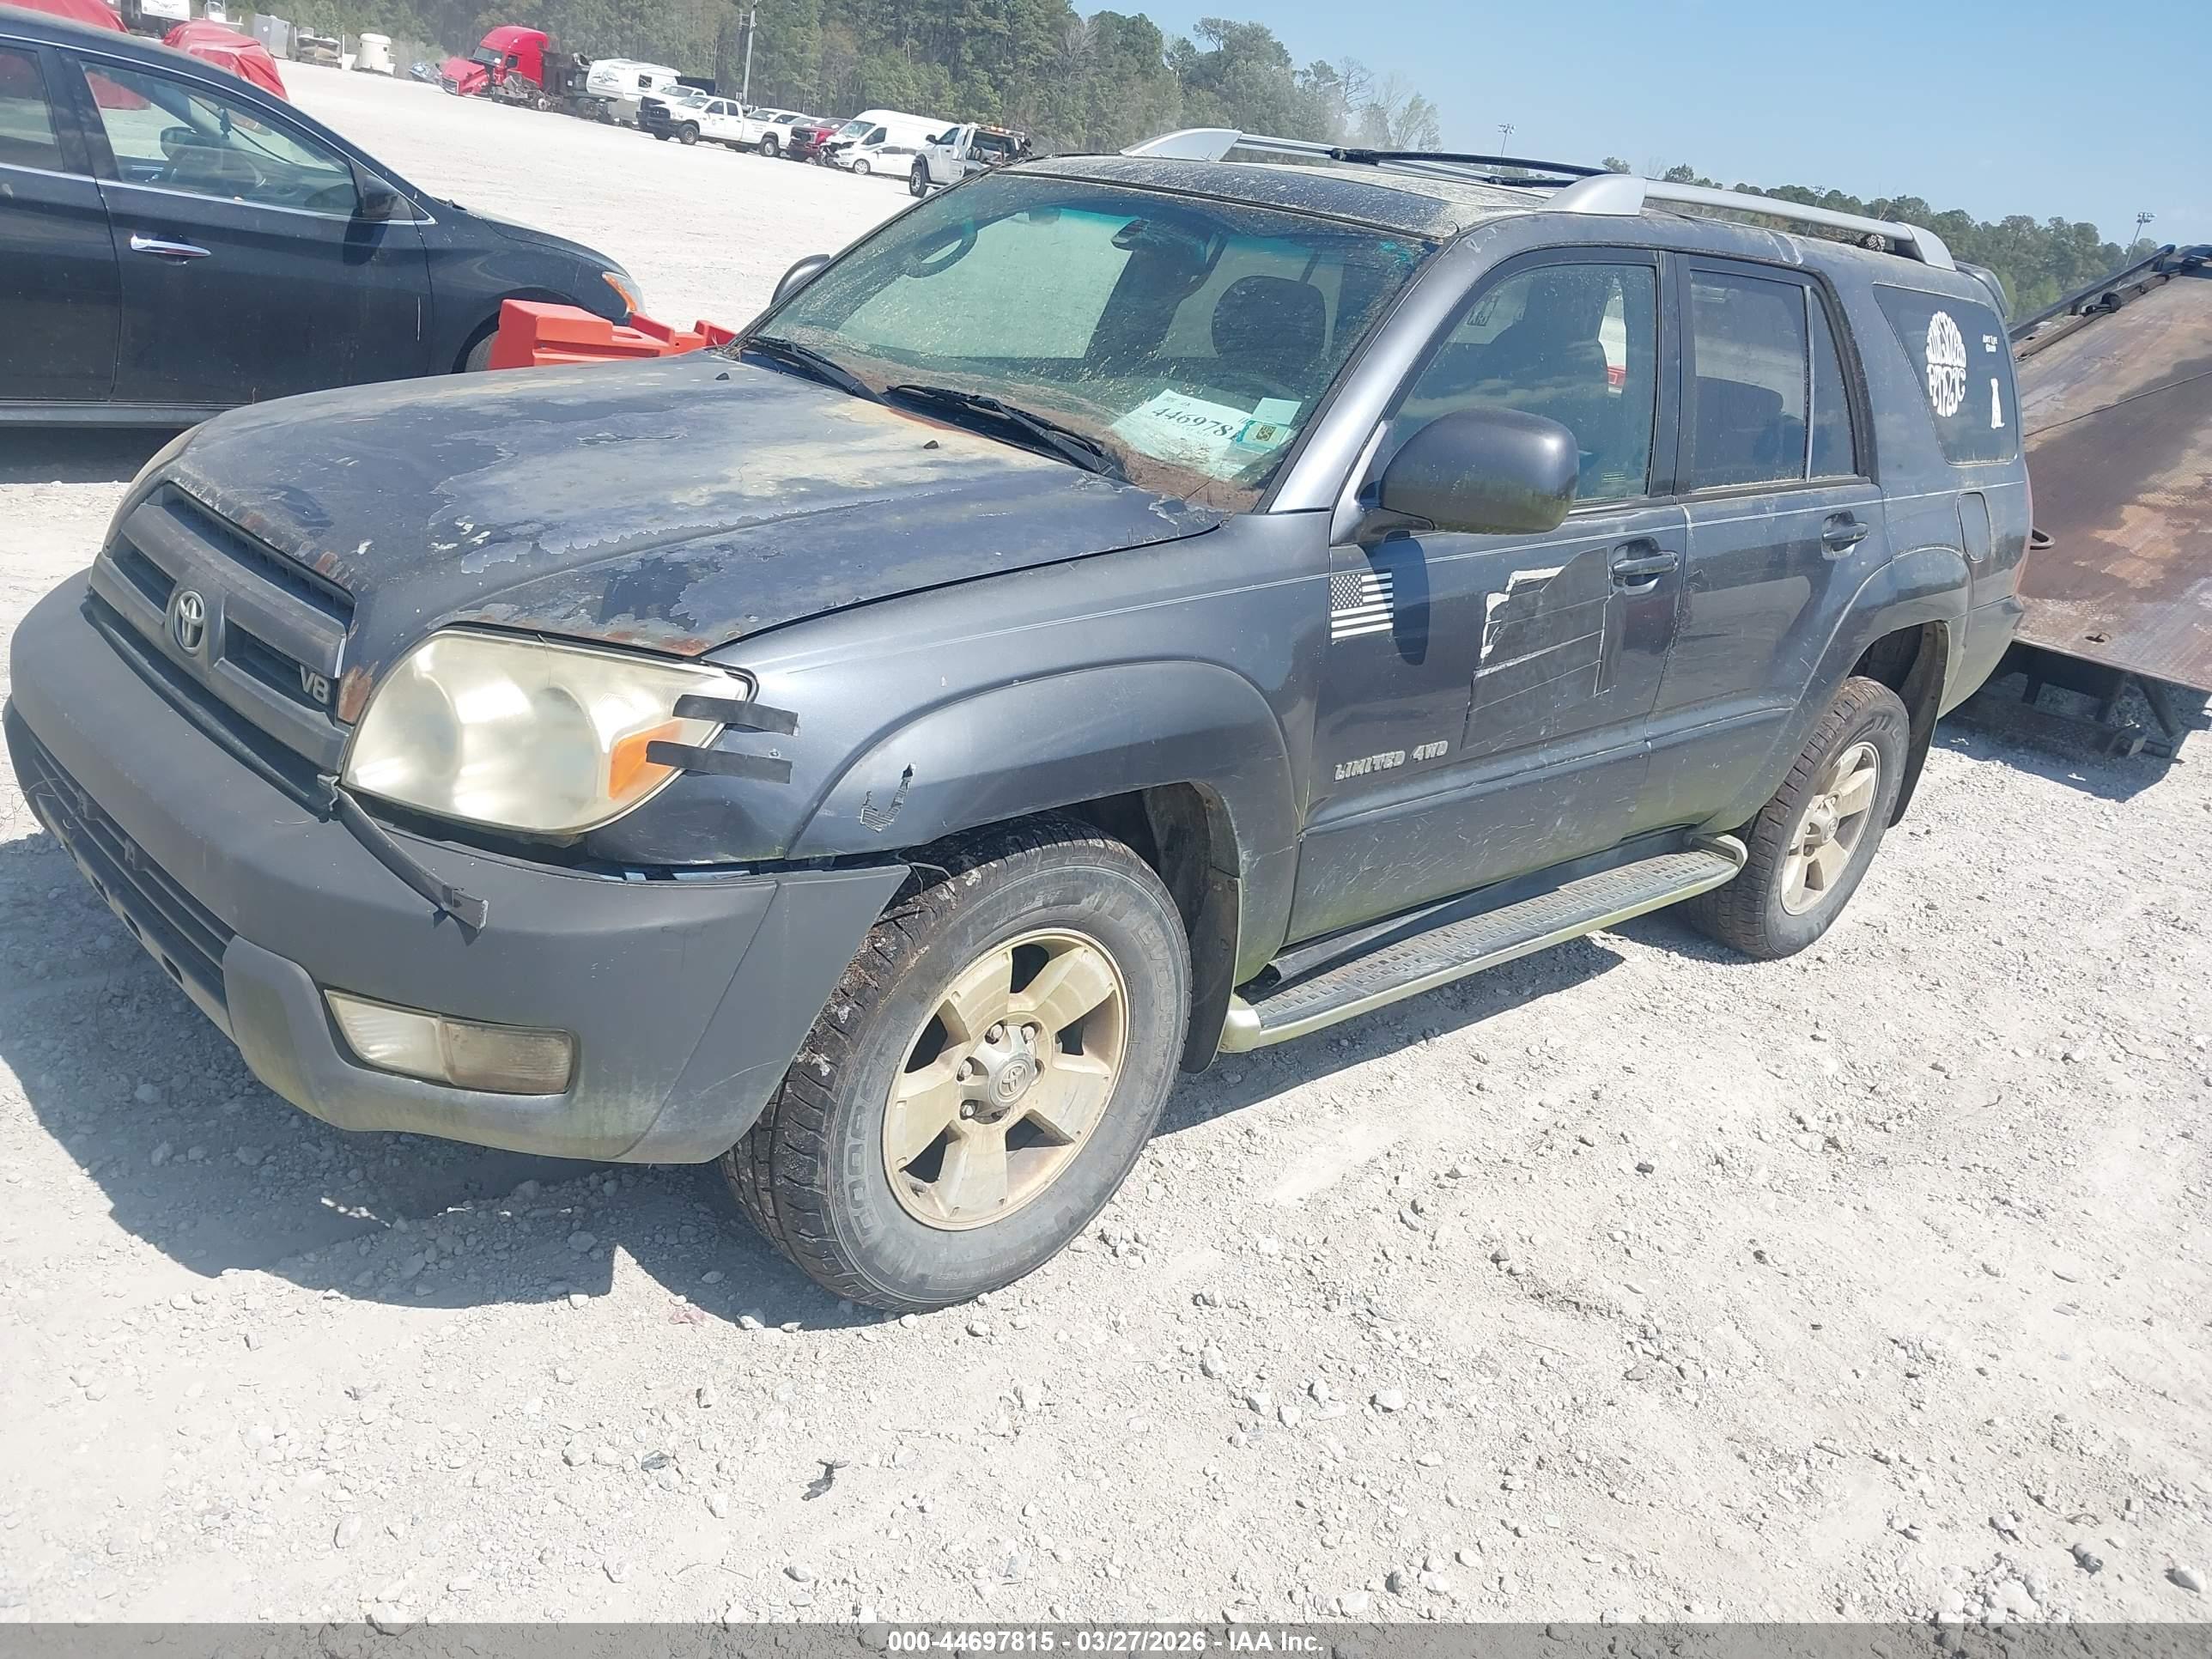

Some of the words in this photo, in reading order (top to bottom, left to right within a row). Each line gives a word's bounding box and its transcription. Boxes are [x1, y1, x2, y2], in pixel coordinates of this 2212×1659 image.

[300, 665, 329, 704] V8
[1333, 750, 1406, 781] LIMITED
[1411, 740, 1449, 762] 4WD
